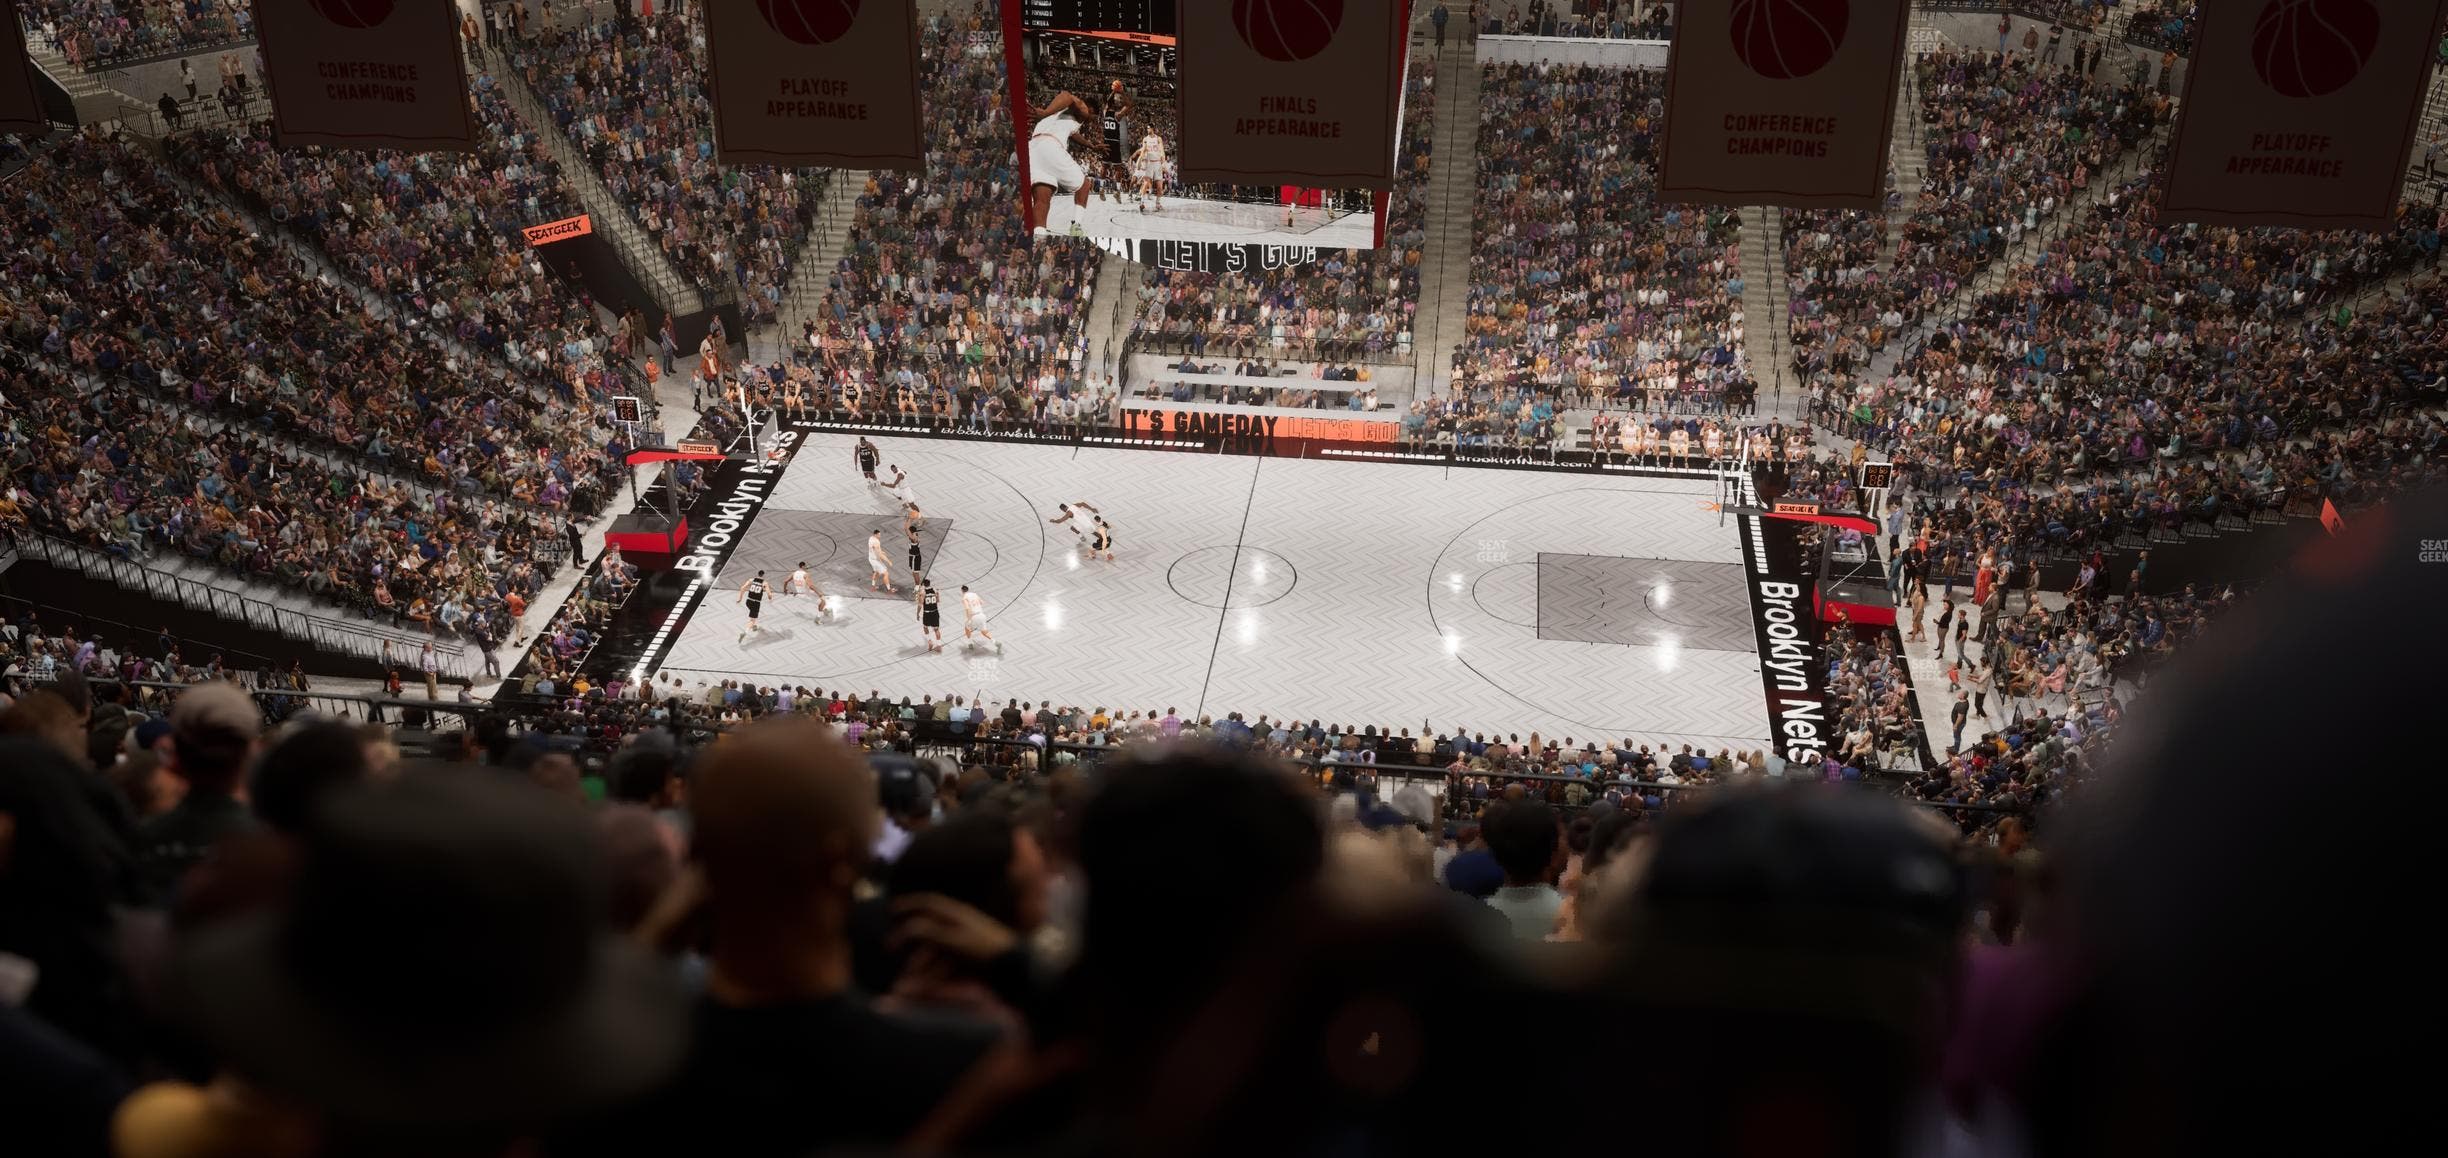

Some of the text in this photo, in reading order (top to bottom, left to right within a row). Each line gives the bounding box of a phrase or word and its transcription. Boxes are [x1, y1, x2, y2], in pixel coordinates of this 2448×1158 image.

[318, 61, 418, 81] CONFERENCE
[327, 83, 417, 103] CHAMPIONS
[781, 78, 849, 96] PLAYOFF
[767, 100, 868, 120] APPEARANCE
[1260, 96, 1316, 114] FINALS
[1235, 118, 1341, 138] APPEARANCE
[1724, 114, 1837, 135] CONFERENCE
[1727, 138, 1828, 158] CHAMPIONS
[2252, 133, 2332, 152] PLAYOFF
[2226, 156, 2343, 178] APPEARANCE
[527, 220, 581, 242] SEATGEEK
[1118, 408, 1401, 443] IT'S GAMEDAY LET'S GO!
[673, 478, 766, 573] Brooklyn
[1759, 581, 1828, 765] Brooklyn Nets
